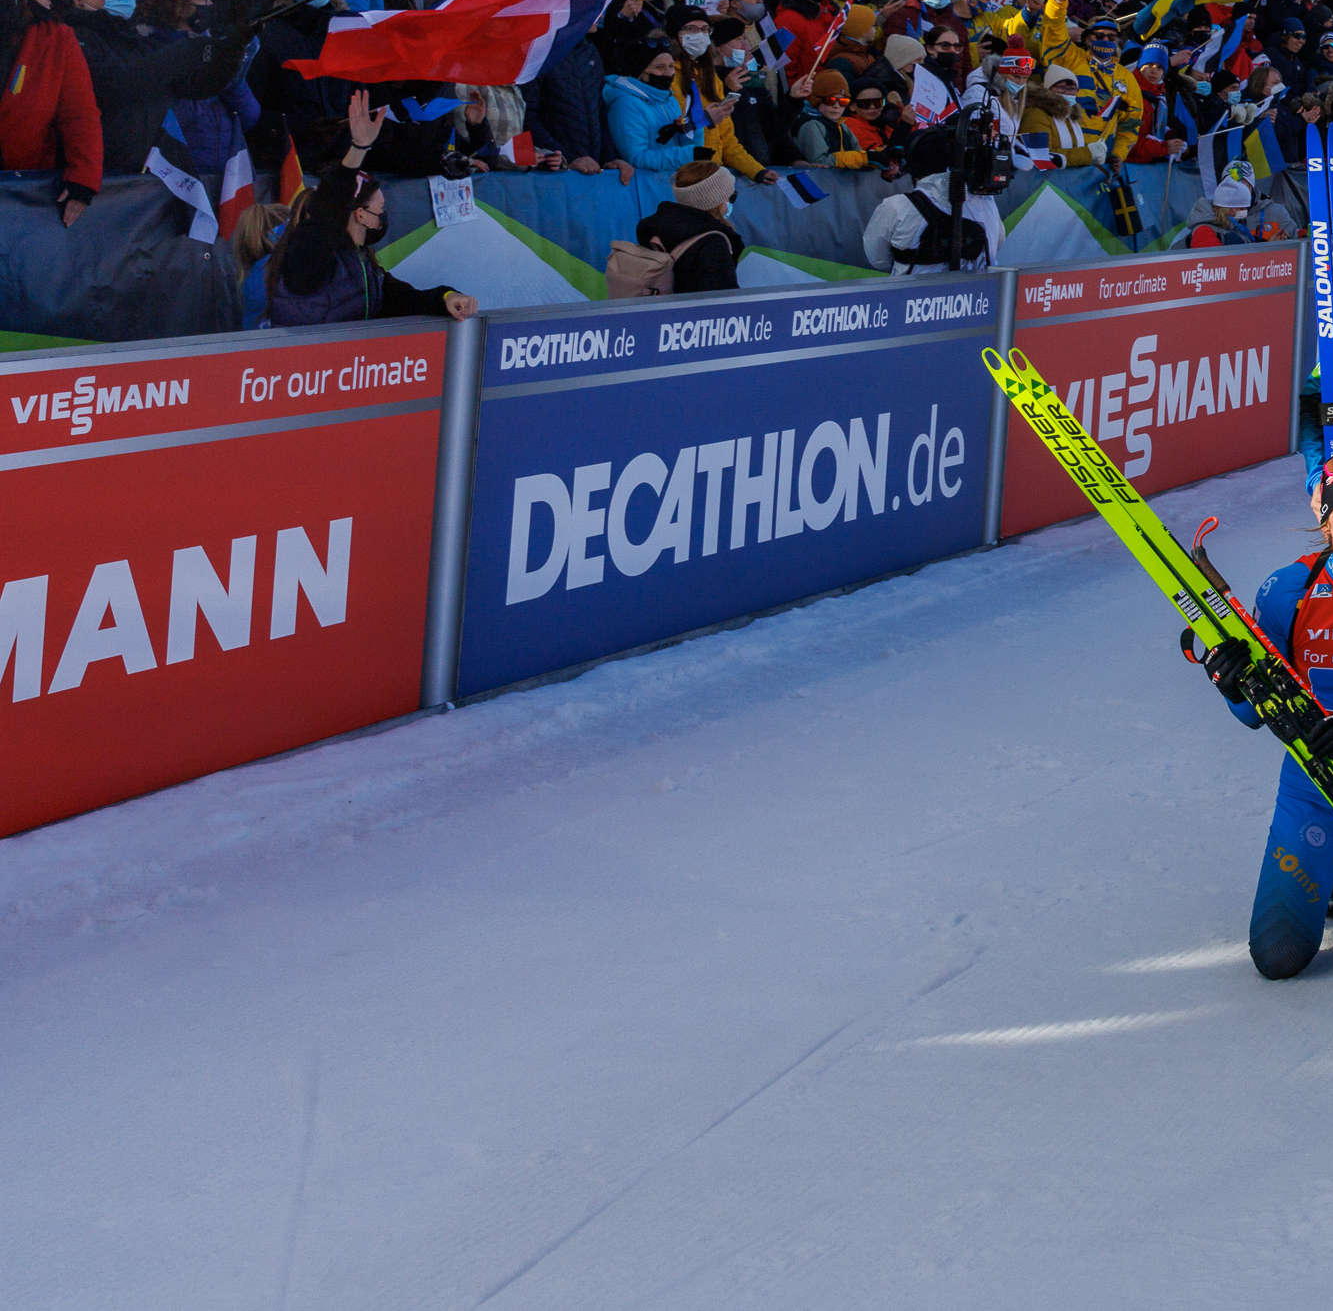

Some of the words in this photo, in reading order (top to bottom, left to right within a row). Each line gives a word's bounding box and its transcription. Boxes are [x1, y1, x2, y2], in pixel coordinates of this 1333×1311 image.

[1025, 278, 1082, 312] VIESSMANN
[1181, 262, 1227, 292] VIESSMANN
[791, 303, 889, 338] DECATHLON.de
[905, 288, 989, 325] DECATHLON.de
[501, 328, 635, 371] DECATHLON.de
[658, 313, 773, 353] DECATHLON.de
[239, 367, 281, 404] for
[287, 366, 333, 400] our
[337, 355, 428, 393] climate
[11, 375, 190, 436] VIESSMANN
[1021, 400, 1113, 505] FISCHER
[1046, 402, 1139, 505] FISCHER
[506, 404, 966, 606] DECATHLON.de
[1303, 649, 1321, 663] for
